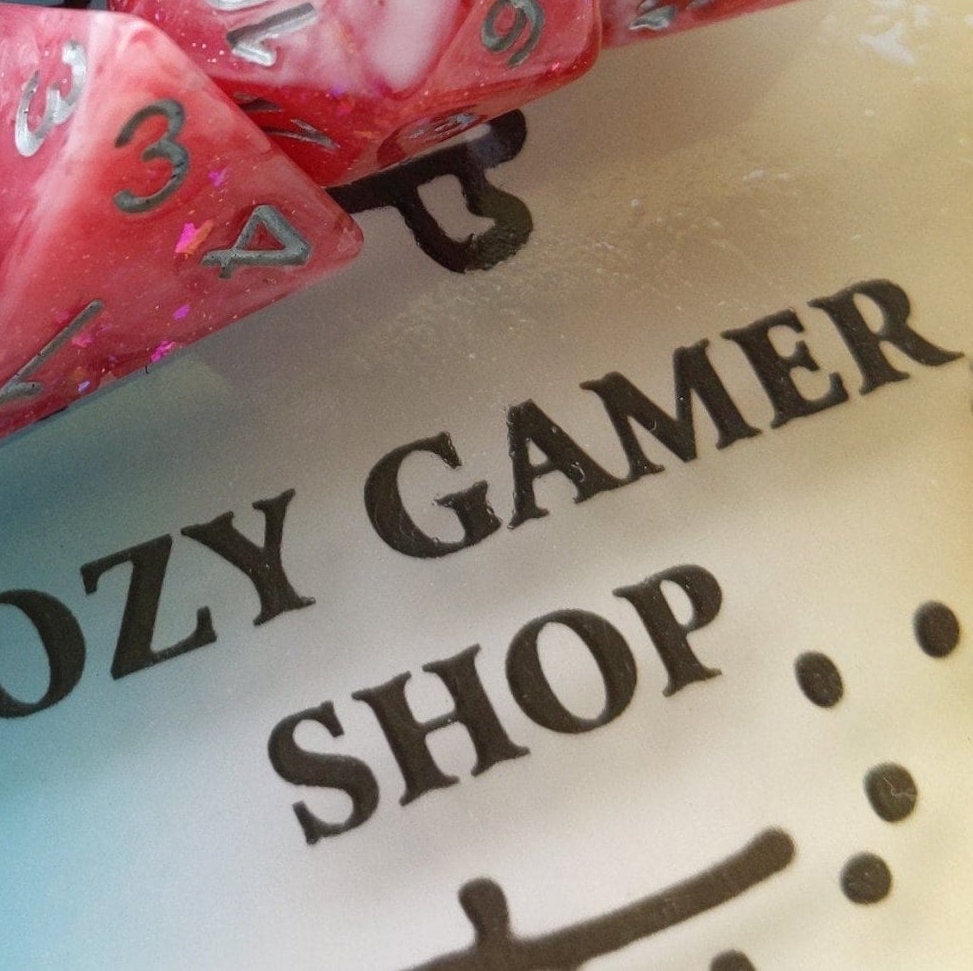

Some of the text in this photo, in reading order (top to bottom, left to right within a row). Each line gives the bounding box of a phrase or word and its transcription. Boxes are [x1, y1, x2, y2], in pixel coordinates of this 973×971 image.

[113, 99, 191, 214] 3
[202, 204, 311, 280] 4
[362, 278, 965, 560] GAMER
[266, 563, 724, 846] SHOP
